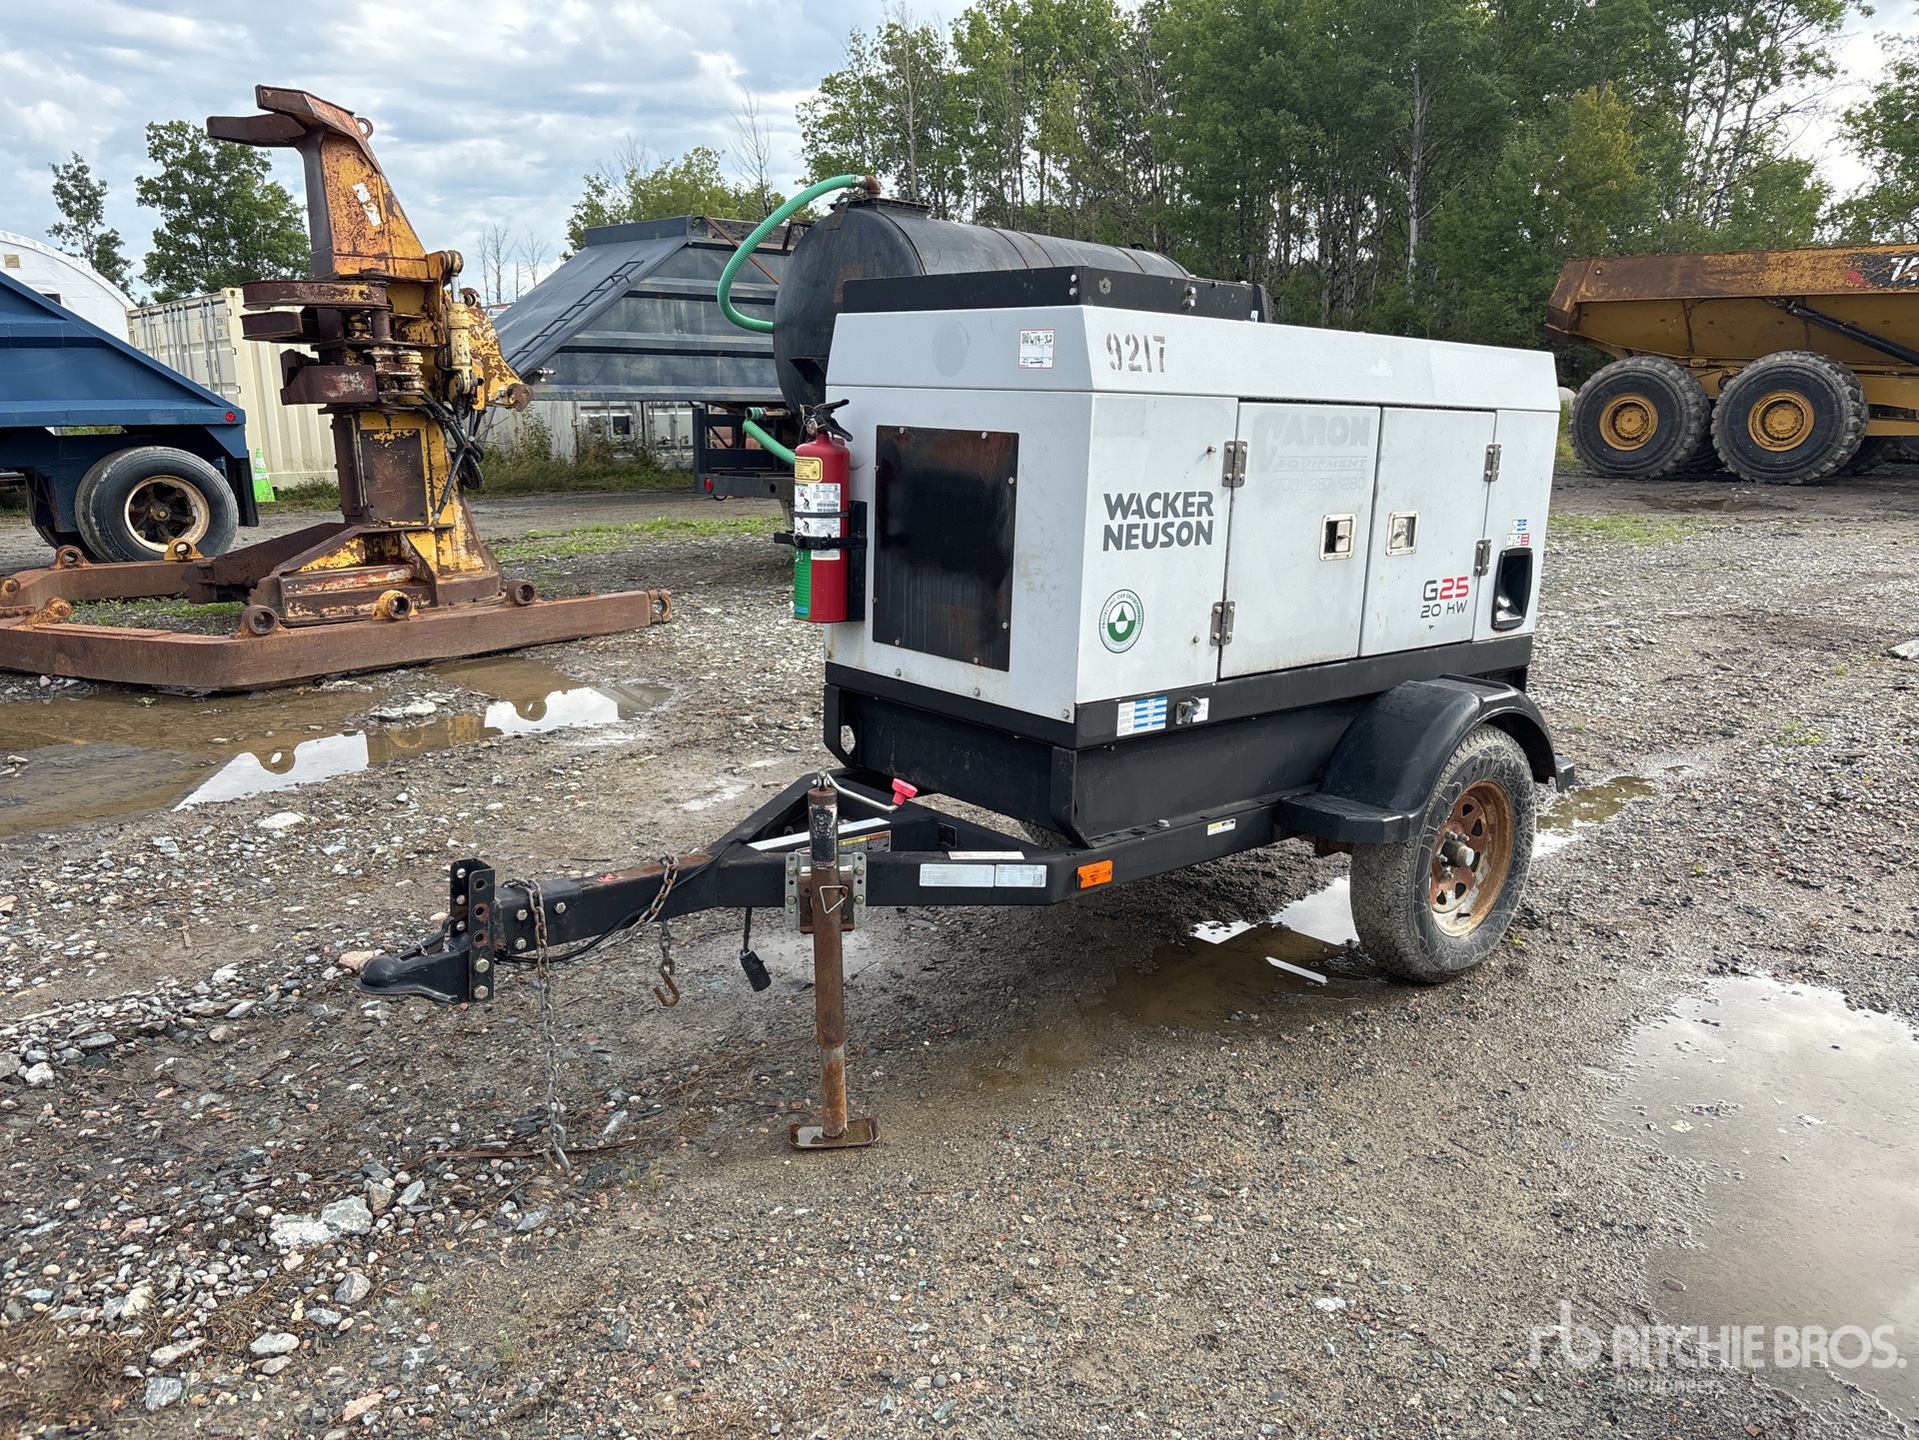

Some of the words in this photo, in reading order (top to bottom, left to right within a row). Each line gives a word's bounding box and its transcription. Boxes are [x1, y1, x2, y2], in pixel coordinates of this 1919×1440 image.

[1106, 332, 1165, 373] 9217
[1250, 412, 1371, 473] CARON
[1276, 459, 1367, 469] EQUIPMENT
[1102, 491, 1214, 520] WACKER
[1102, 520, 1214, 551] NEUSON
[1422, 576, 1469, 602] G25
[1420, 603, 1441, 618] 20
